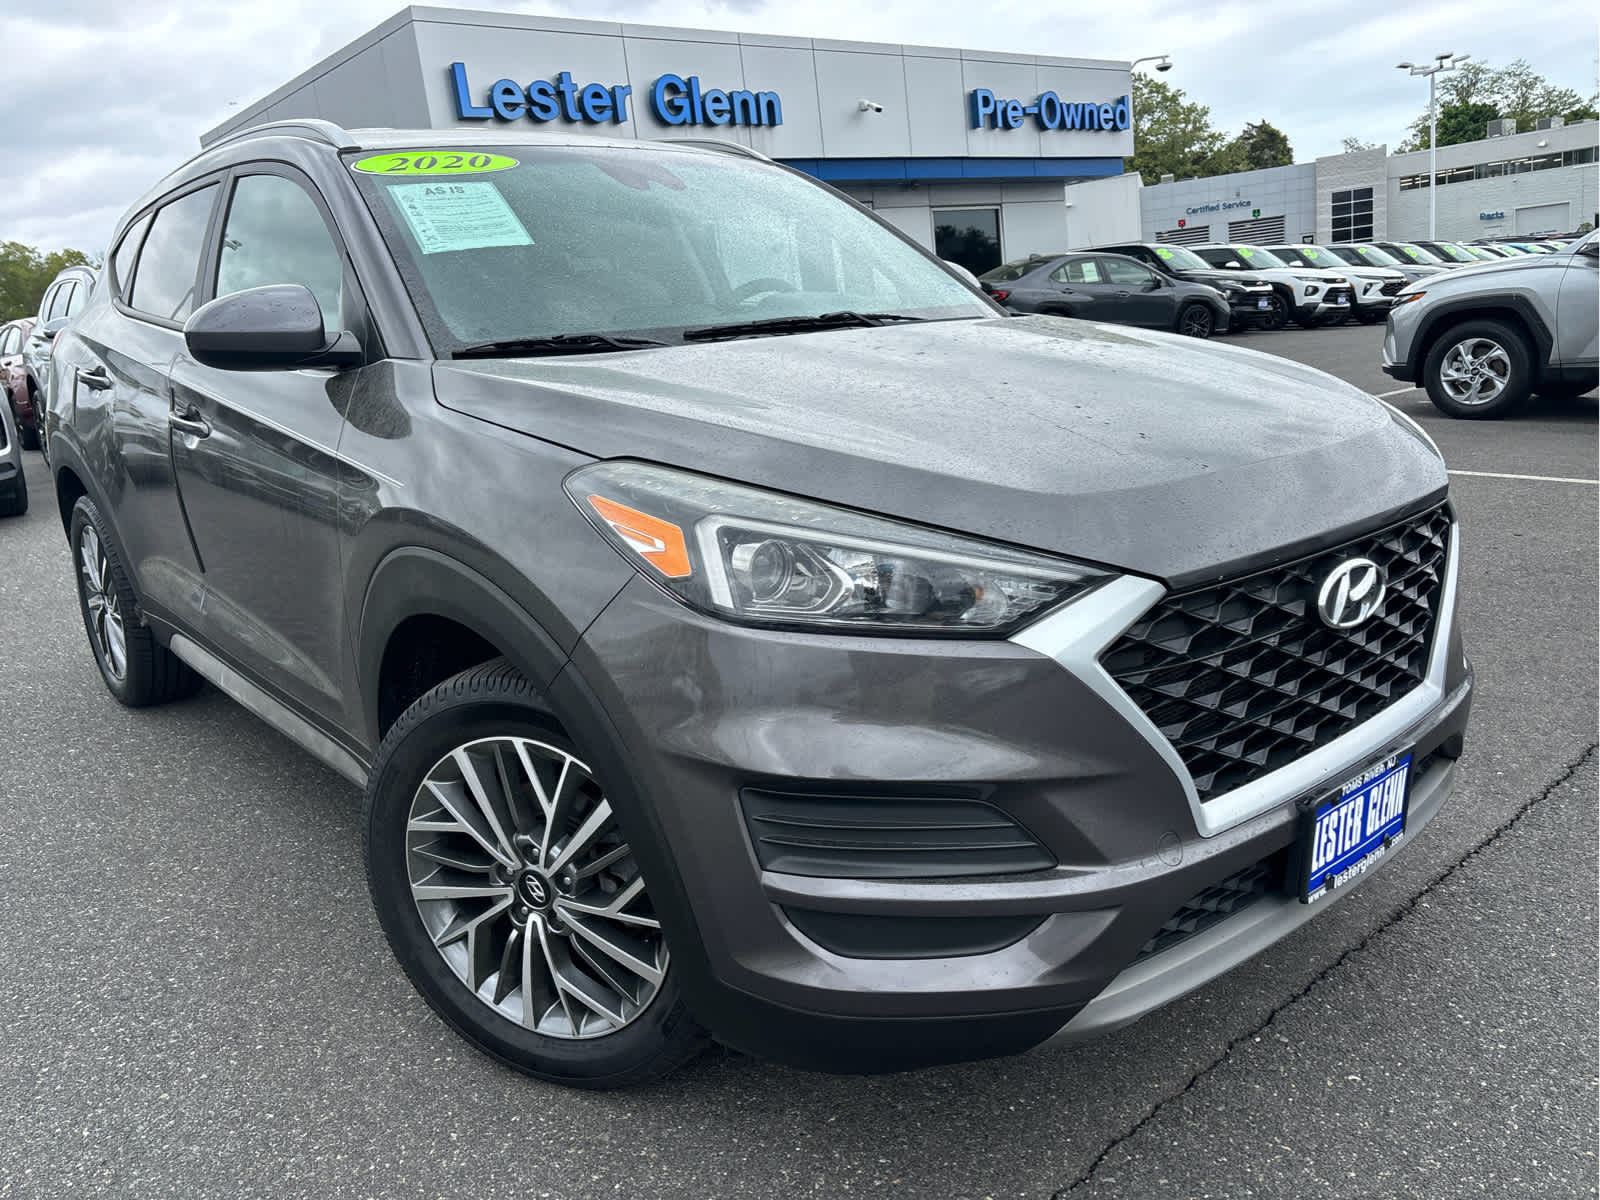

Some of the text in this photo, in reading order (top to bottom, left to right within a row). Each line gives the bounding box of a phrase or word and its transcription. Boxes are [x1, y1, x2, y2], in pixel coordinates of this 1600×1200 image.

[449, 62, 783, 126] Lester Glenn
[971, 88, 1130, 131] Pre-Owned
[386, 154, 492, 172] 2020
[424, 185, 465, 196] AS IS
[1186, 200, 1252, 215] Certified Service
[1480, 211, 1505, 221] Parts
[1342, 776, 1363, 796] TOMS
[1363, 764, 1386, 784] RIVER
[1311, 767, 1409, 873] LESTER GLENN
